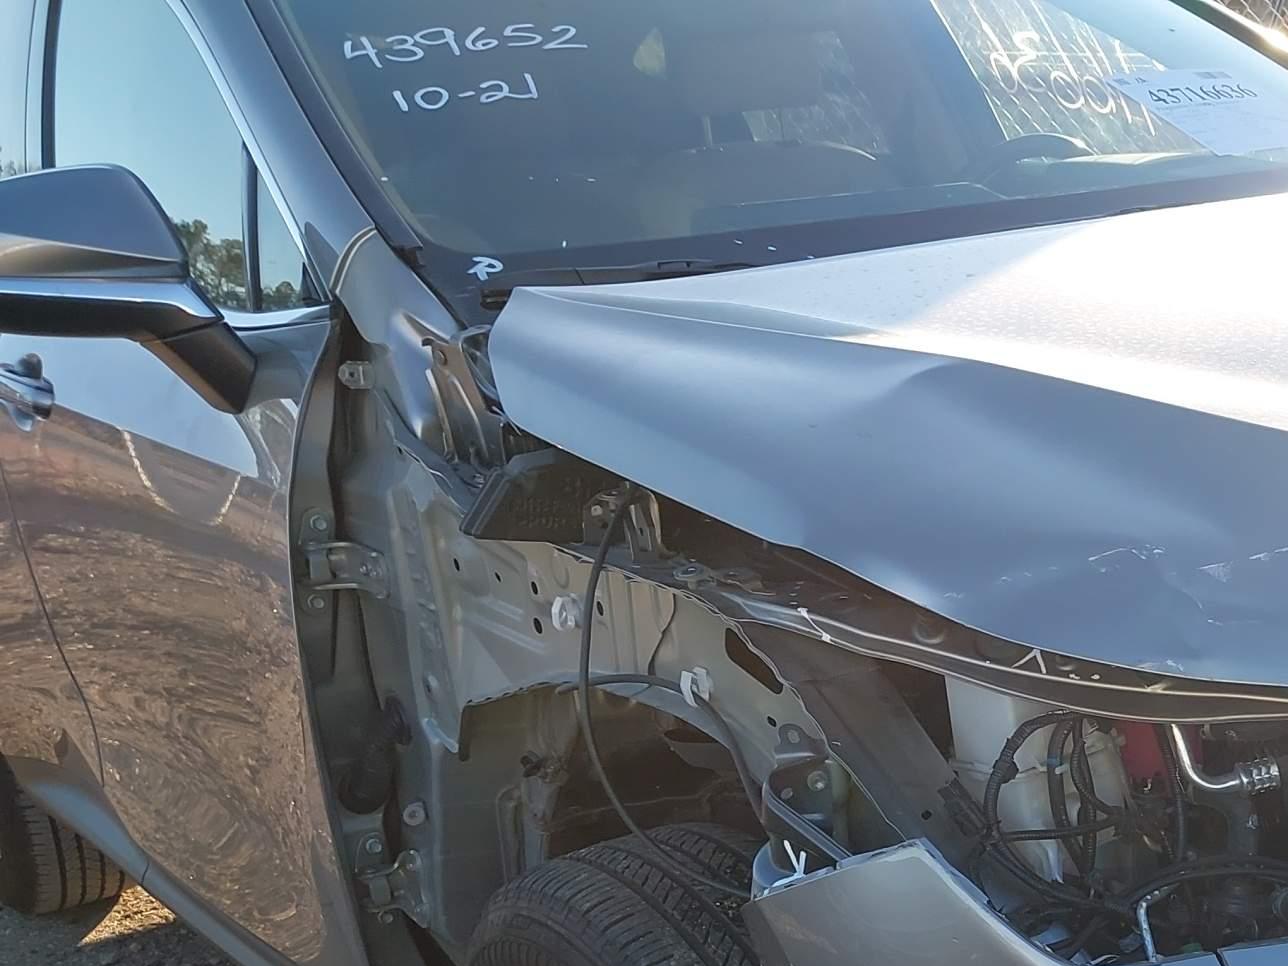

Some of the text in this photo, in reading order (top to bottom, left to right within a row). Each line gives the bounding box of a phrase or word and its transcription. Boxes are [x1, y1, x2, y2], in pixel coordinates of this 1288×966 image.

[343, 23, 588, 68] 439652
[392, 73, 539, 112] 10-21
[1147, 83, 1259, 105] 43716636
